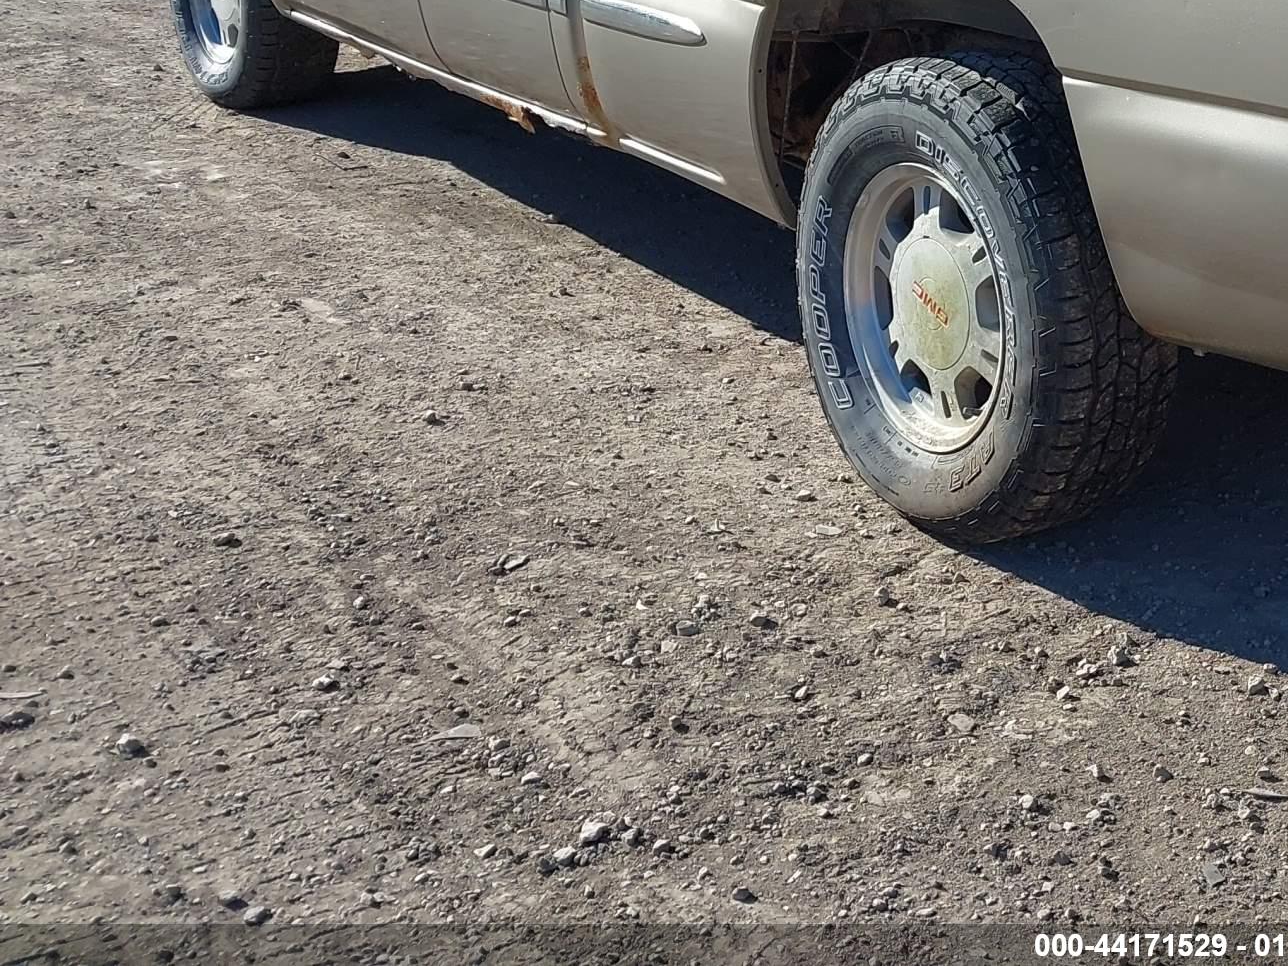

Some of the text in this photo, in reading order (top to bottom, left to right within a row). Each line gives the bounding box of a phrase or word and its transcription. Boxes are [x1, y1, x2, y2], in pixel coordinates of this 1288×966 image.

[808, 194, 854, 410] COOPER
[911, 280, 950, 328] GMC
[915, 130, 1017, 420] DISCOVERER
